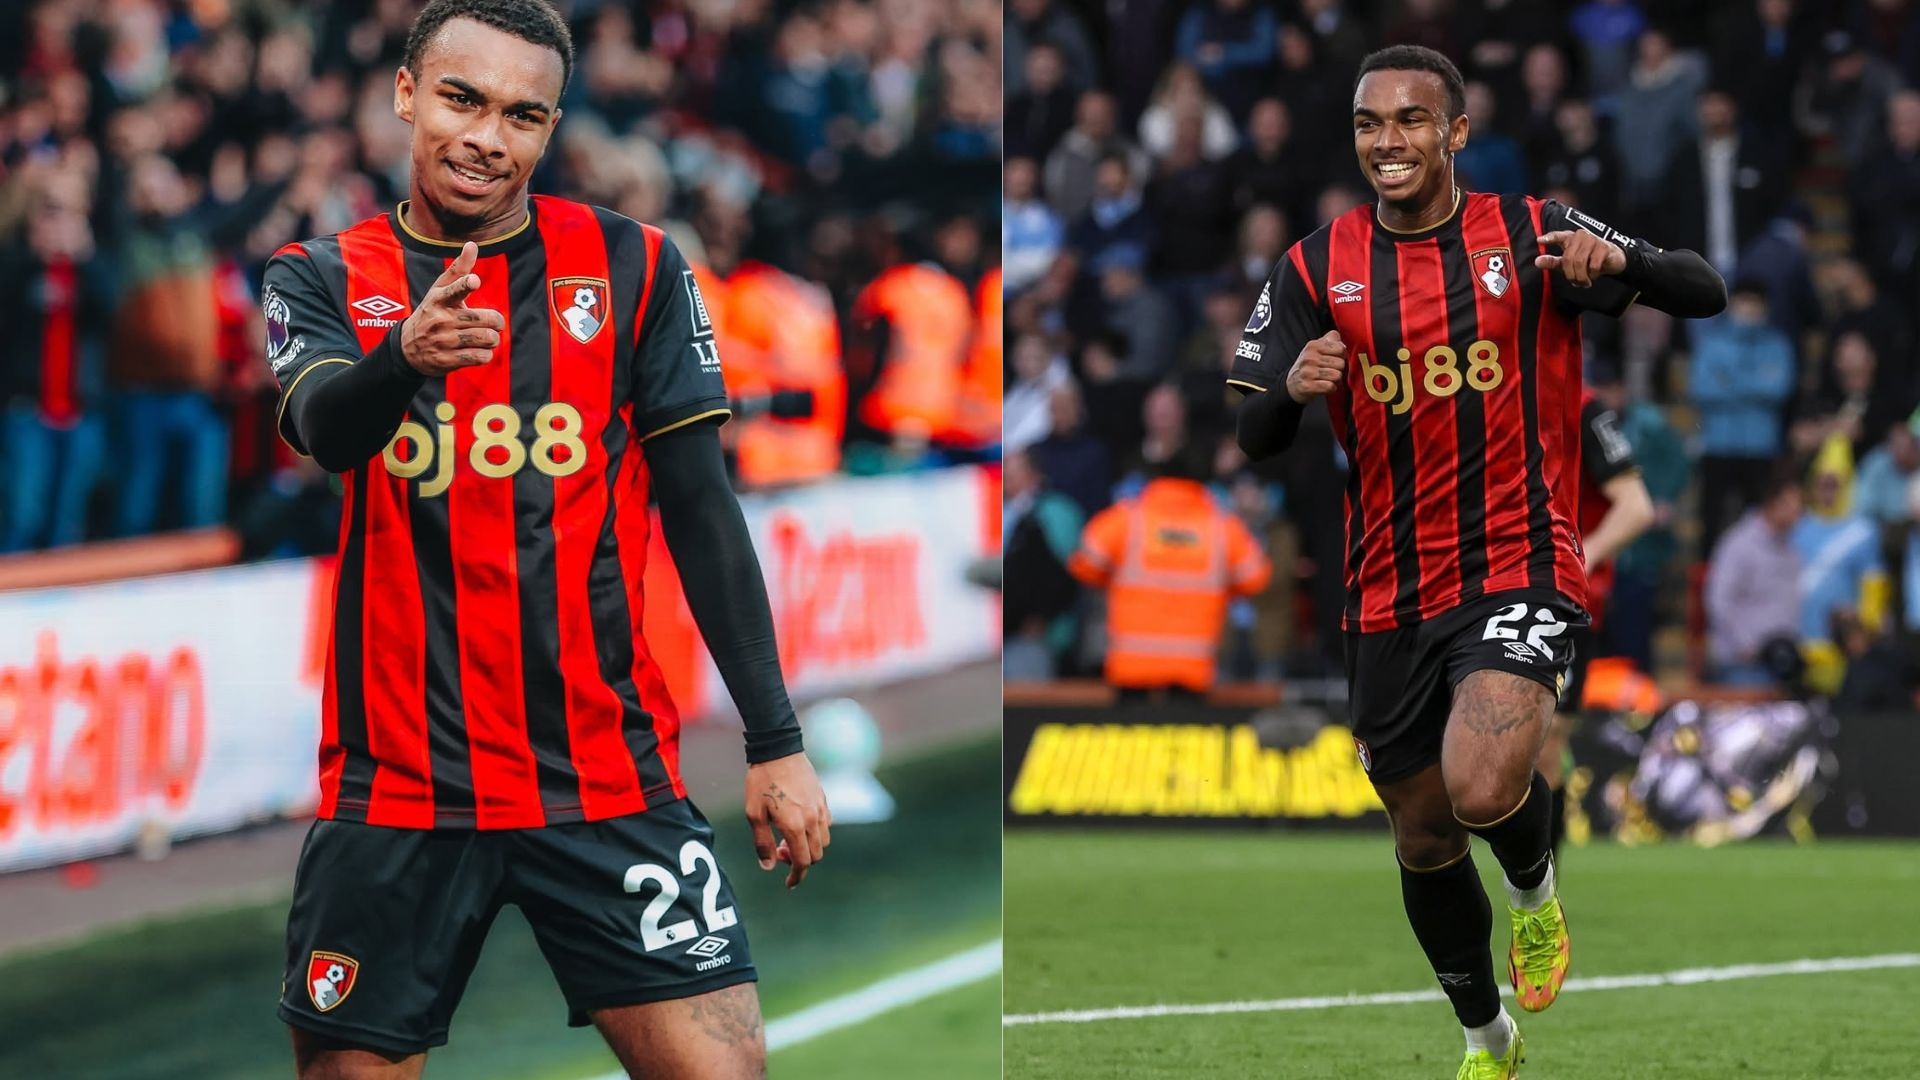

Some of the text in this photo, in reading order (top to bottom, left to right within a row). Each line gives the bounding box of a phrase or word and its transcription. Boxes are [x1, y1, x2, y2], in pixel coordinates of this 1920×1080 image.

[1334, 294, 1362, 304] umbro
[1358, 340, 1504, 415] bj88
[1482, 602, 1568, 662] 22
[1504, 652, 1533, 664] umbro
[623, 840, 739, 952] 22
[696, 954, 731, 972] umbro
